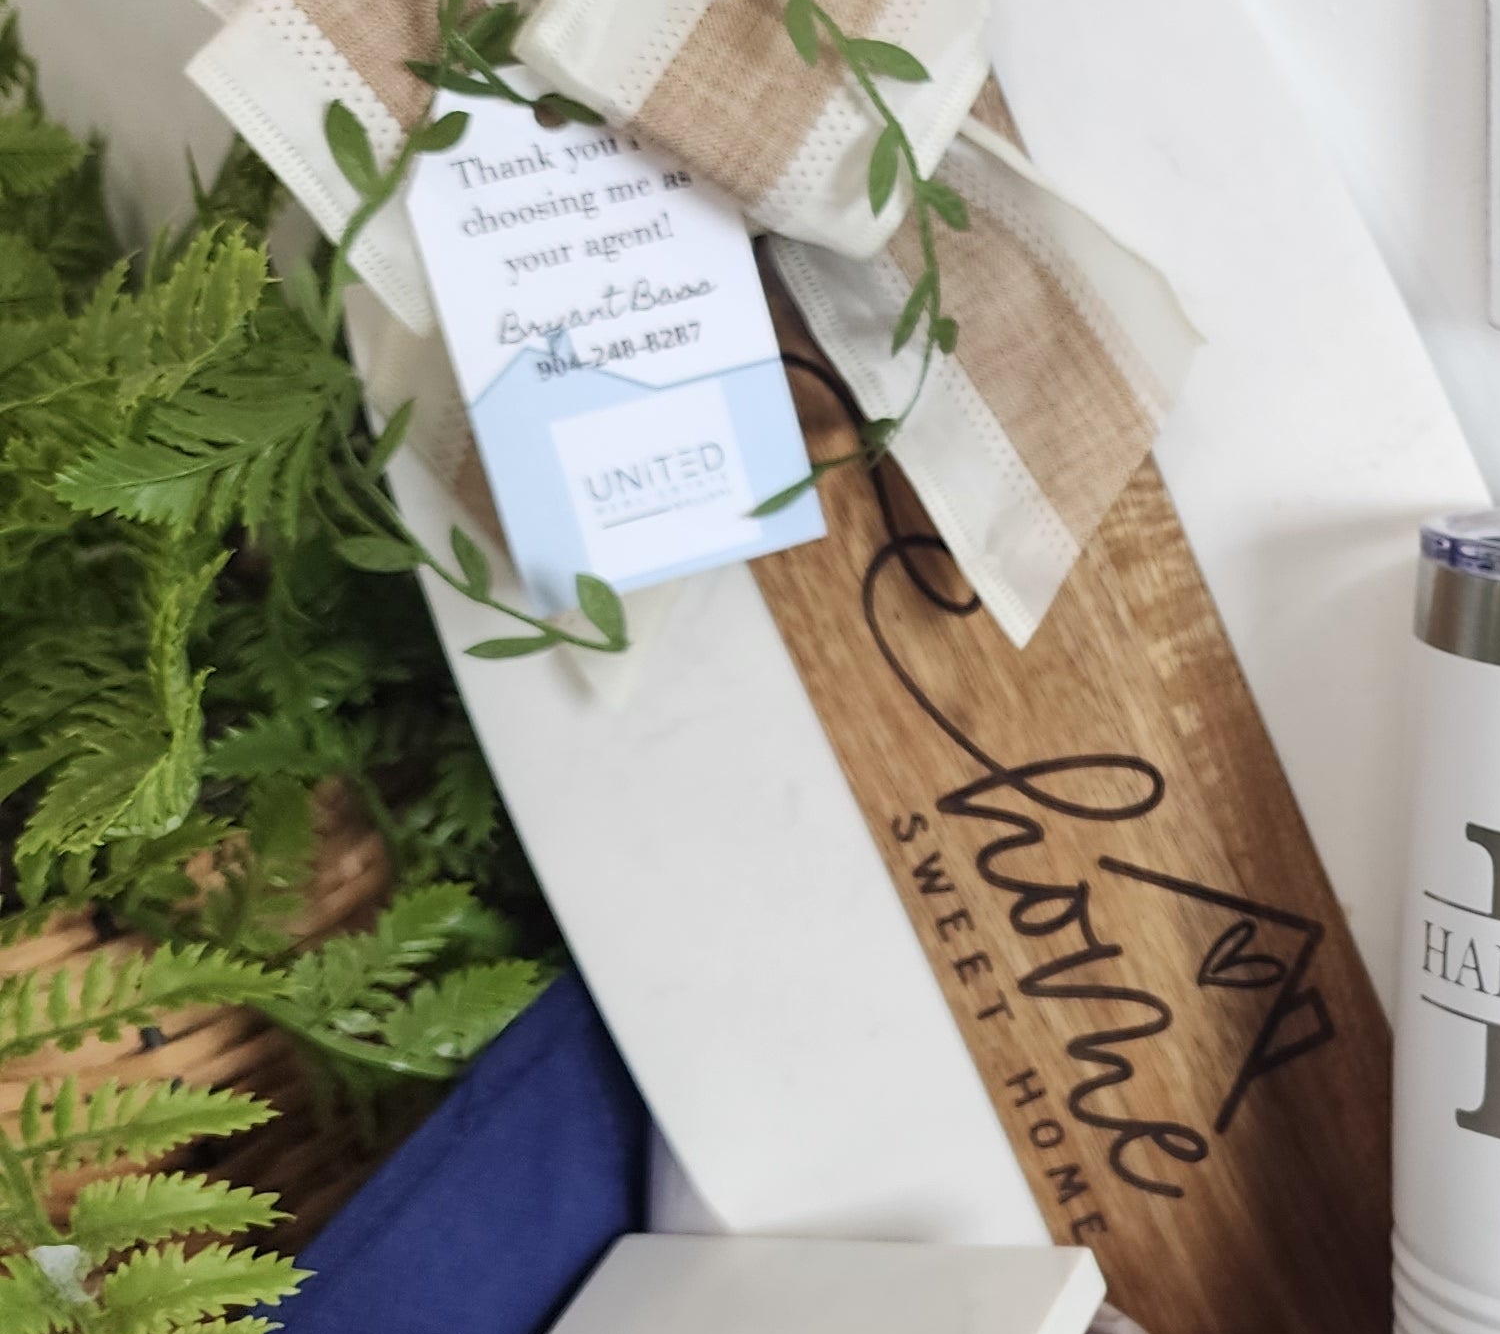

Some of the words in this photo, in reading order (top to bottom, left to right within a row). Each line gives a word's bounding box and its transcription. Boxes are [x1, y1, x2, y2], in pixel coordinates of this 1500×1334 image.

[450, 143, 558, 189] Thank
[562, 136, 621, 175] you
[461, 190, 600, 237] choosing
[606, 176, 652, 205] me
[503, 245, 573, 286] your
[585, 212, 675, 263] agent!
[583, 441, 726, 503] UNITED
[928, 743, 1211, 1199] home
[891, 810, 1015, 1024] SWEET
[1004, 1067, 1109, 1245] HOME
